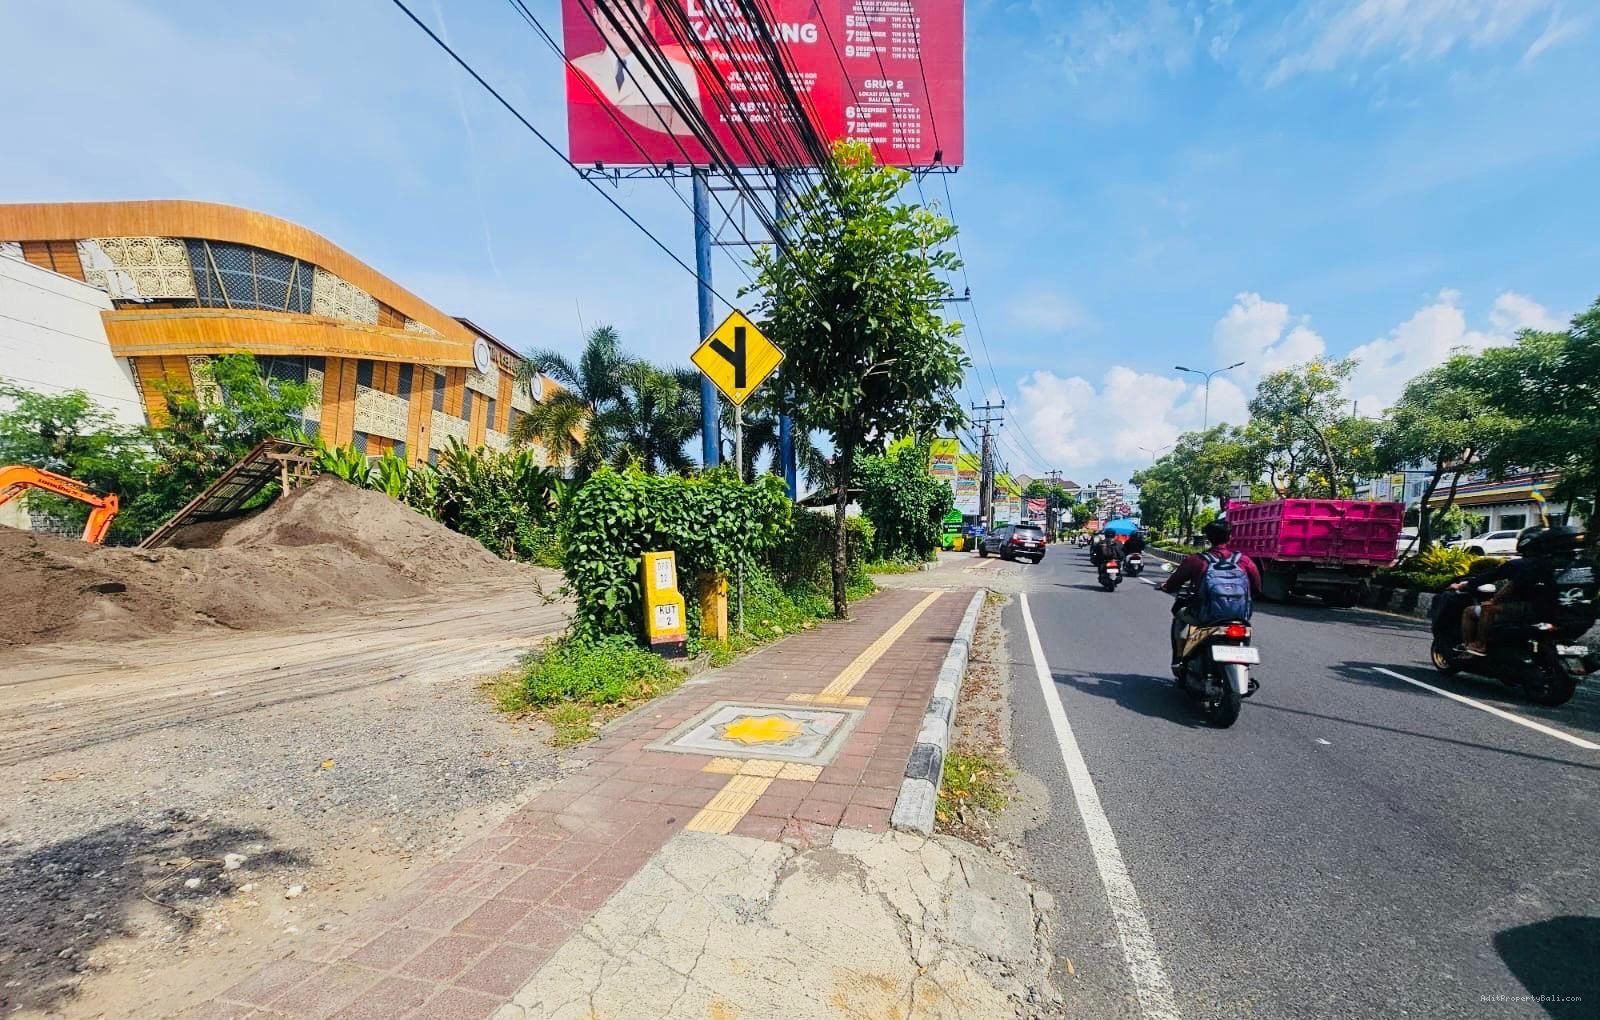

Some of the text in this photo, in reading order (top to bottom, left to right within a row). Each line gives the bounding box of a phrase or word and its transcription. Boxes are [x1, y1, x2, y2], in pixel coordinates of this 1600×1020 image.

[846, 30, 854, 42] 7
[846, 46, 854, 56] 9
[864, 80, 904, 89] GRUP 2
[846, 106, 855, 118] 6
[847, 121, 855, 133] 7
[660, 606, 676, 615] KUT
[667, 617, 672, 626] 2
